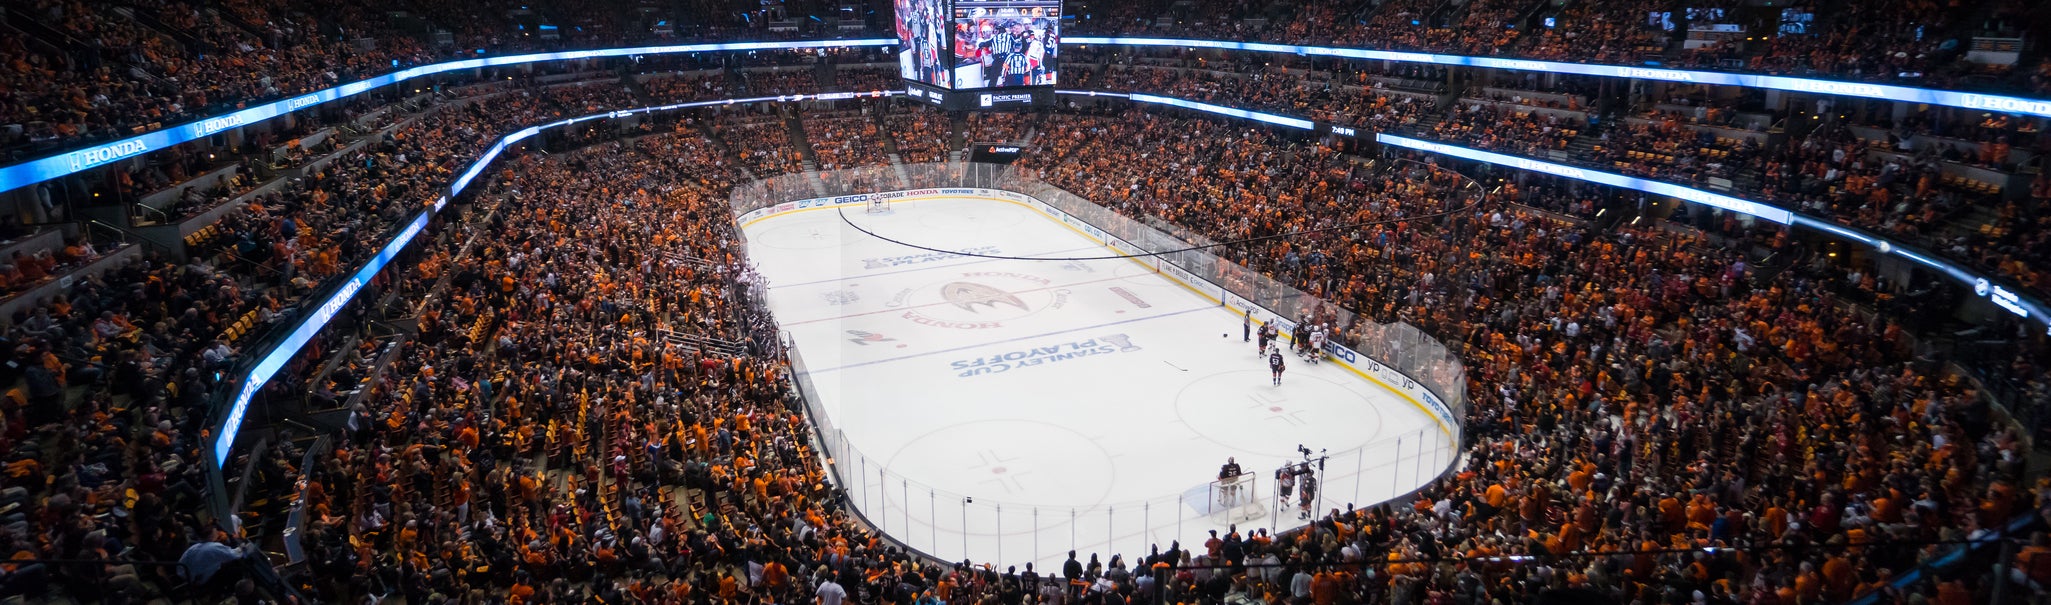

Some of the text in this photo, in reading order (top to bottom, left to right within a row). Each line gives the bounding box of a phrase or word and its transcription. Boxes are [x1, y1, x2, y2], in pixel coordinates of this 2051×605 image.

[1501, 59, 1547, 71] HONDA
[1632, 68, 1693, 81] HONDA
[1810, 81, 1884, 97] HONDA
[293, 94, 320, 108] HONDA
[204, 114, 243, 133] HONDA
[1345, 128, 1354, 137] PM
[84, 139, 147, 166] HONDA
[835, 195, 867, 204] GEICO
[907, 189, 939, 197] HONDA
[962, 272, 1050, 286] HONDA
[329, 278, 361, 315] HONDA
[1236, 299, 1260, 315] ActivePDF
[902, 311, 1004, 330] HONDA
[950, 338, 1099, 370] PLAYOFFS
[958, 345, 1115, 378] STANLEY CUP
[1367, 360, 1380, 373] yp
[1402, 376, 1414, 390] yp
[229, 373, 262, 432] HONDA
[1422, 391, 1440, 412] TOYO
